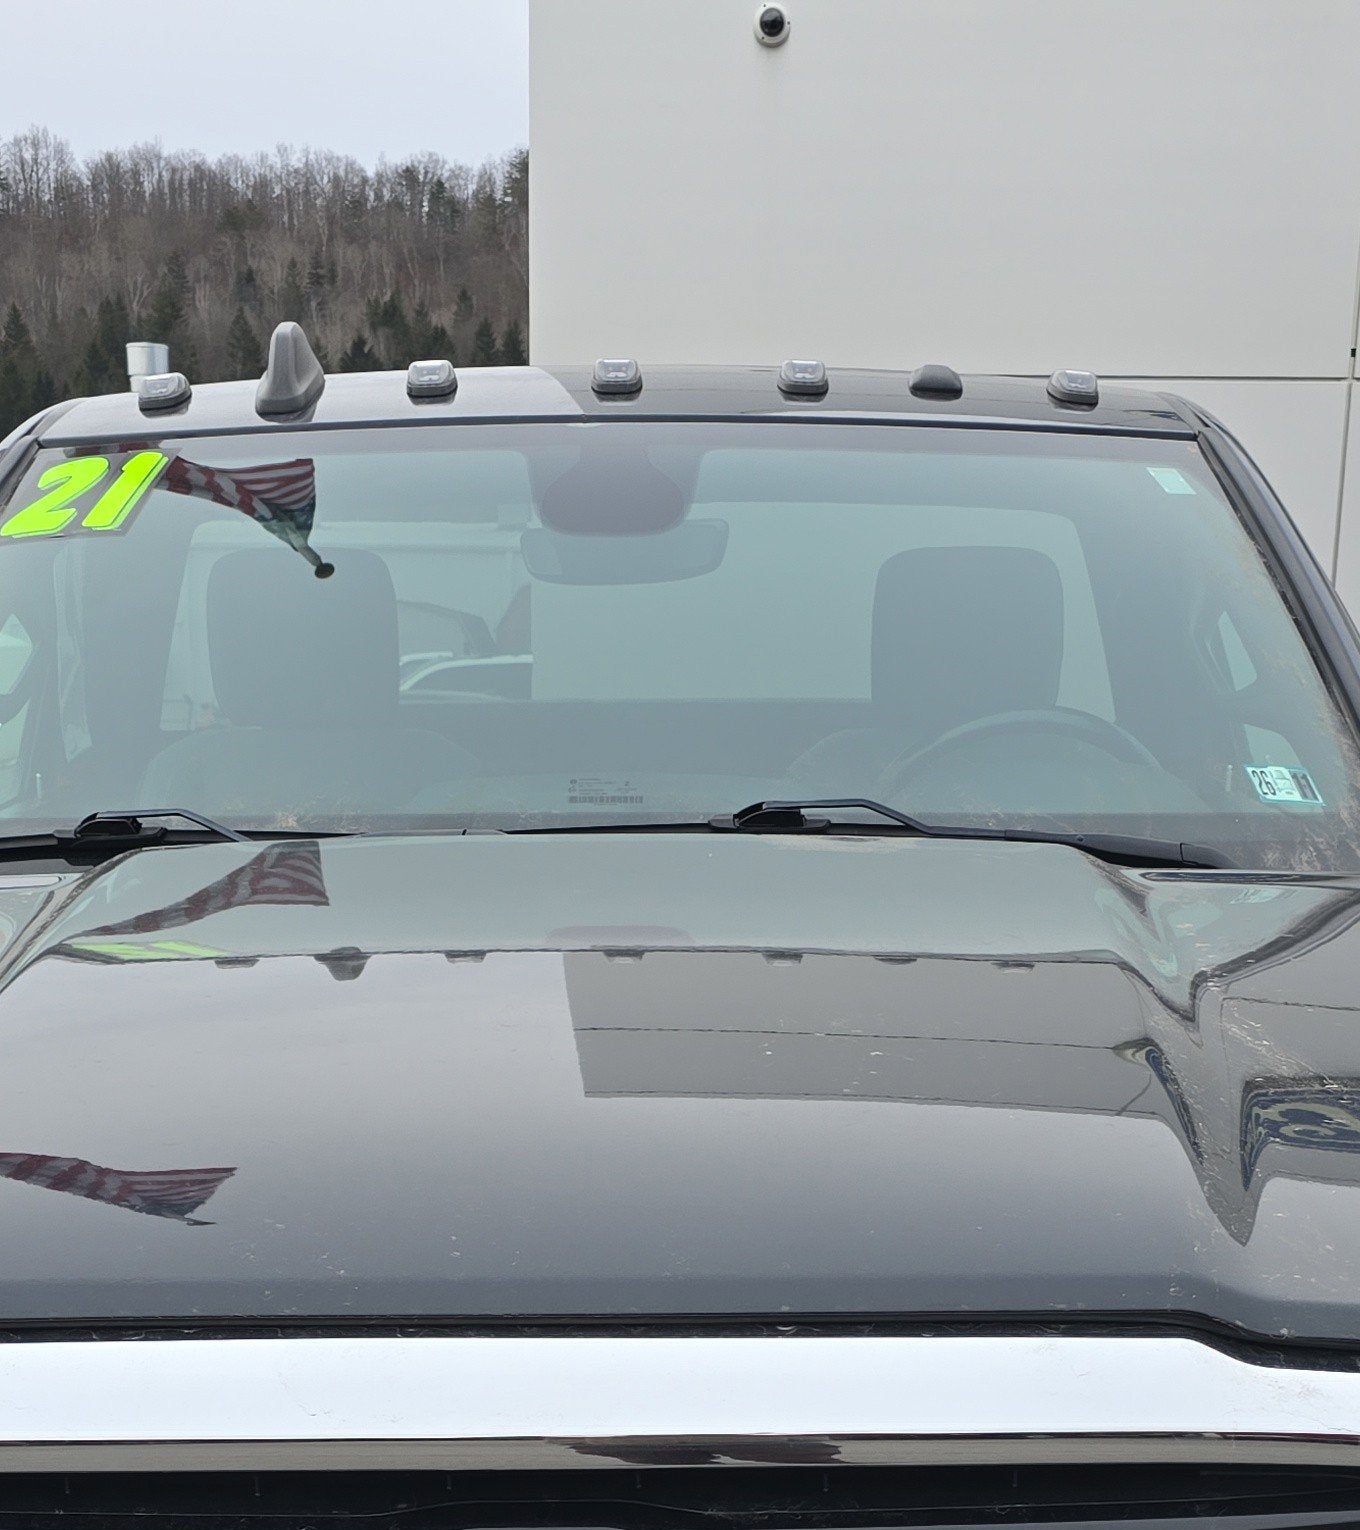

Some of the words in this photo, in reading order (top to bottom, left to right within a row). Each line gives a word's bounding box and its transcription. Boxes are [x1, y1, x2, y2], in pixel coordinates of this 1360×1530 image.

[0, 452, 169, 538] 21
[1251, 769, 1277, 796] 26
[1290, 772, 1321, 802] 11
